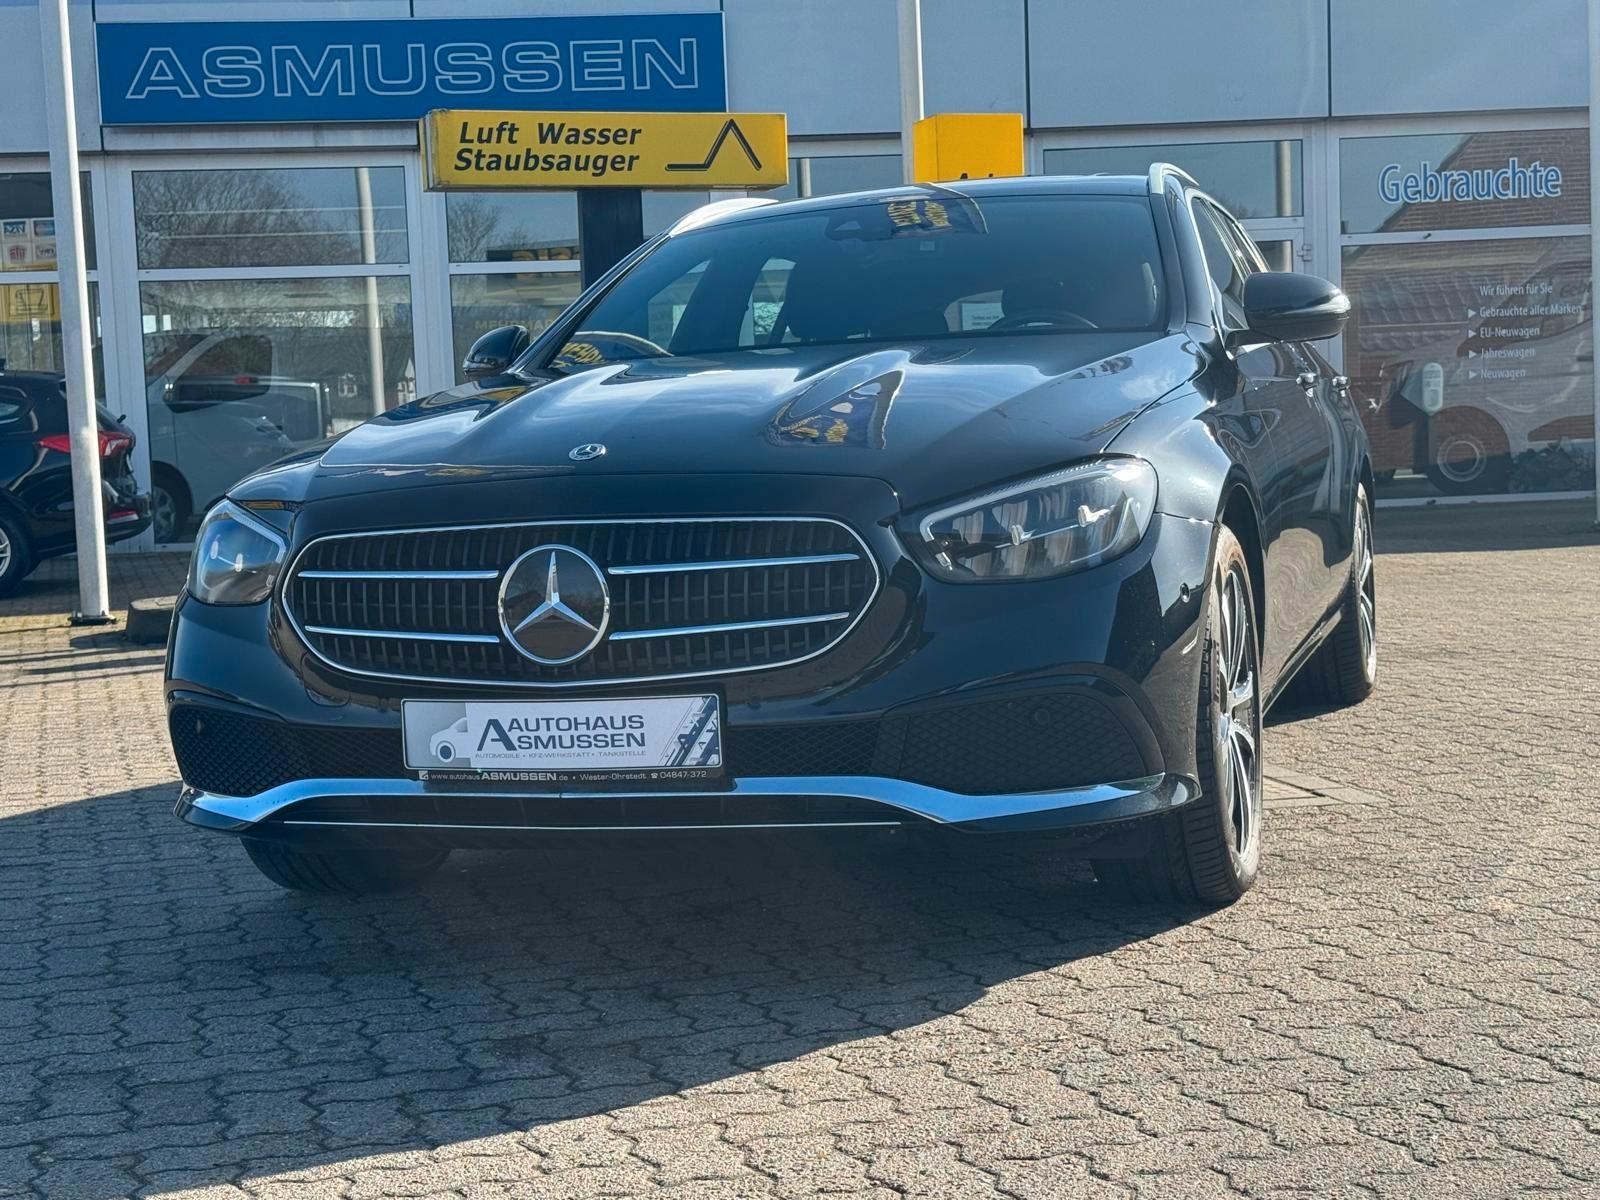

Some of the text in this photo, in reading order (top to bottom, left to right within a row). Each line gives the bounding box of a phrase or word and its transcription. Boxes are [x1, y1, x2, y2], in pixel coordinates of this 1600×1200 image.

[124, 37, 699, 99] ASMUSSEN
[459, 121, 642, 145] Luft Wasser
[453, 147, 640, 175] Staubsauger
[1378, 157, 1562, 204] Gebrauchte
[1479, 285, 1494, 297] Wir
[1540, 282, 1553, 294] Sie
[1479, 303, 1583, 318] Gebrauchte aller Marken
[1480, 326, 1540, 339] EU-Neuwagen
[1480, 347, 1536, 360] Jahreswagen
[1480, 368, 1526, 381] Neuwagen
[507, 714, 645, 733] AUTOHAUS
[477, 718, 646, 752] ASMUSSEN
[598, 750, 646, 758] TANKSTELLE
[579, 771, 647, 781] Wester-Ohrstedt
[659, 770, 708, 779] 04847-372
